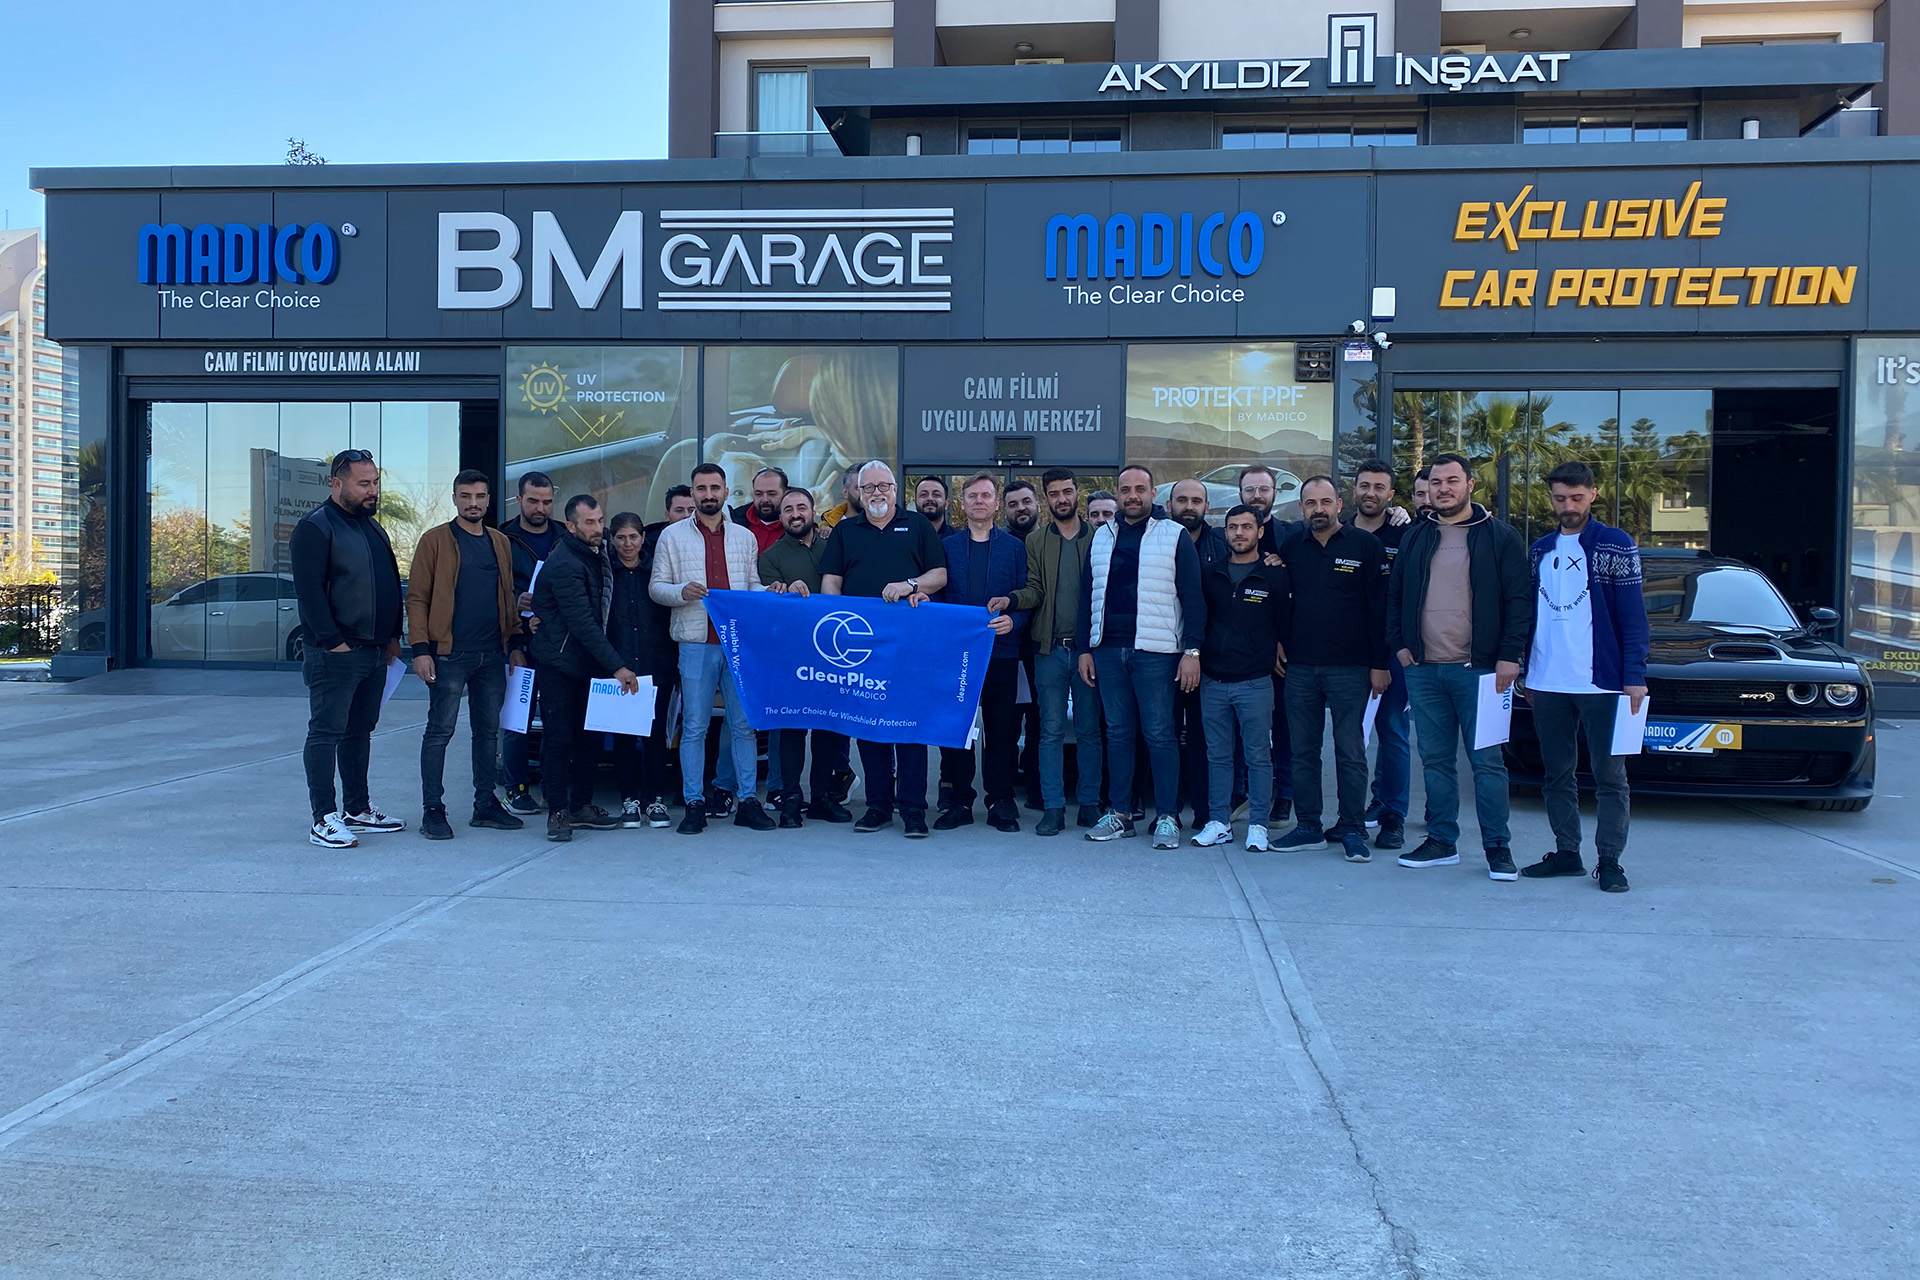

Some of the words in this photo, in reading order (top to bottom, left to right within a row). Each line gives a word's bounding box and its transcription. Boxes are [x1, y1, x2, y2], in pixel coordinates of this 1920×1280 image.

[1098, 60, 1310, 92] AKYILDIZ
[1395, 52, 1571, 92] İNŞAAT
[1453, 181, 1728, 252] EXCLUSIVE
[138, 222, 335, 284] MADICO
[1046, 210, 1265, 280] MADICO
[437, 210, 644, 310] BM
[659, 232, 953, 286] GARAGE
[158, 290, 194, 308] The
[199, 289, 250, 309] Clear
[255, 289, 321, 308] Choice
[1063, 285, 1102, 305] The
[1109, 284, 1165, 304] Clear
[1171, 283, 1245, 303] Choice
[1439, 269, 1538, 308] CAR
[1547, 266, 1858, 308] PROTECTION
[204, 351, 238, 372] CAM
[289, 351, 371, 372] UYGULAMA
[375, 351, 420, 372] ALANI
[533, 382, 556, 395] UV
[577, 374, 597, 386] UV
[964, 377, 1003, 400] CAM
[1010, 372, 1059, 399] FİLMİ
[576, 391, 666, 403] PROTECTION
[1262, 385, 1307, 407] PPF
[921, 410, 1017, 432] UYGULAMA
[1023, 405, 1101, 432] MERKEZİ
[1238, 413, 1252, 422] BY
[1257, 412, 1307, 422] MADICO
[730, 618, 740, 653] Invisible
[956, 651, 969, 703] clearplex.com
[1863, 661, 1887, 670] CAR
[519, 670, 532, 704] MADICO
[796, 666, 887, 691] ClearPlex
[839, 687, 850, 695] BY
[852, 689, 887, 701] MADICO
[765, 707, 778, 715] The
[780, 706, 800, 715] Clear
[802, 706, 827, 716] Choice
[828, 708, 839, 718] for
[840, 711, 877, 726] Windshield
[878, 718, 918, 727] Protection
